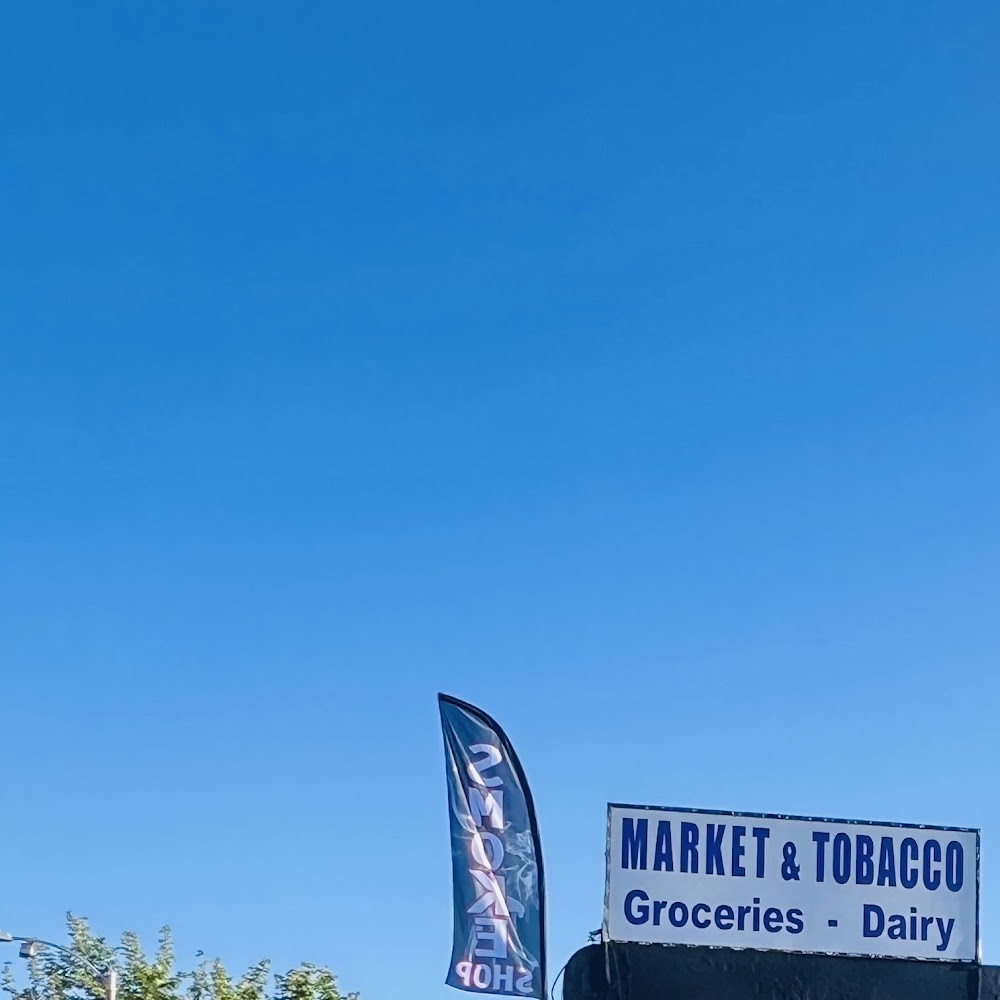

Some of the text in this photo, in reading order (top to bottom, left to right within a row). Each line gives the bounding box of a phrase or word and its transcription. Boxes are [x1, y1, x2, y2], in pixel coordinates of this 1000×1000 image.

[621, 817, 964, 892] MARKET & TOBACCO
[624, 889, 804, 934] Groceries
[863, 904, 955, 951] Dairy
